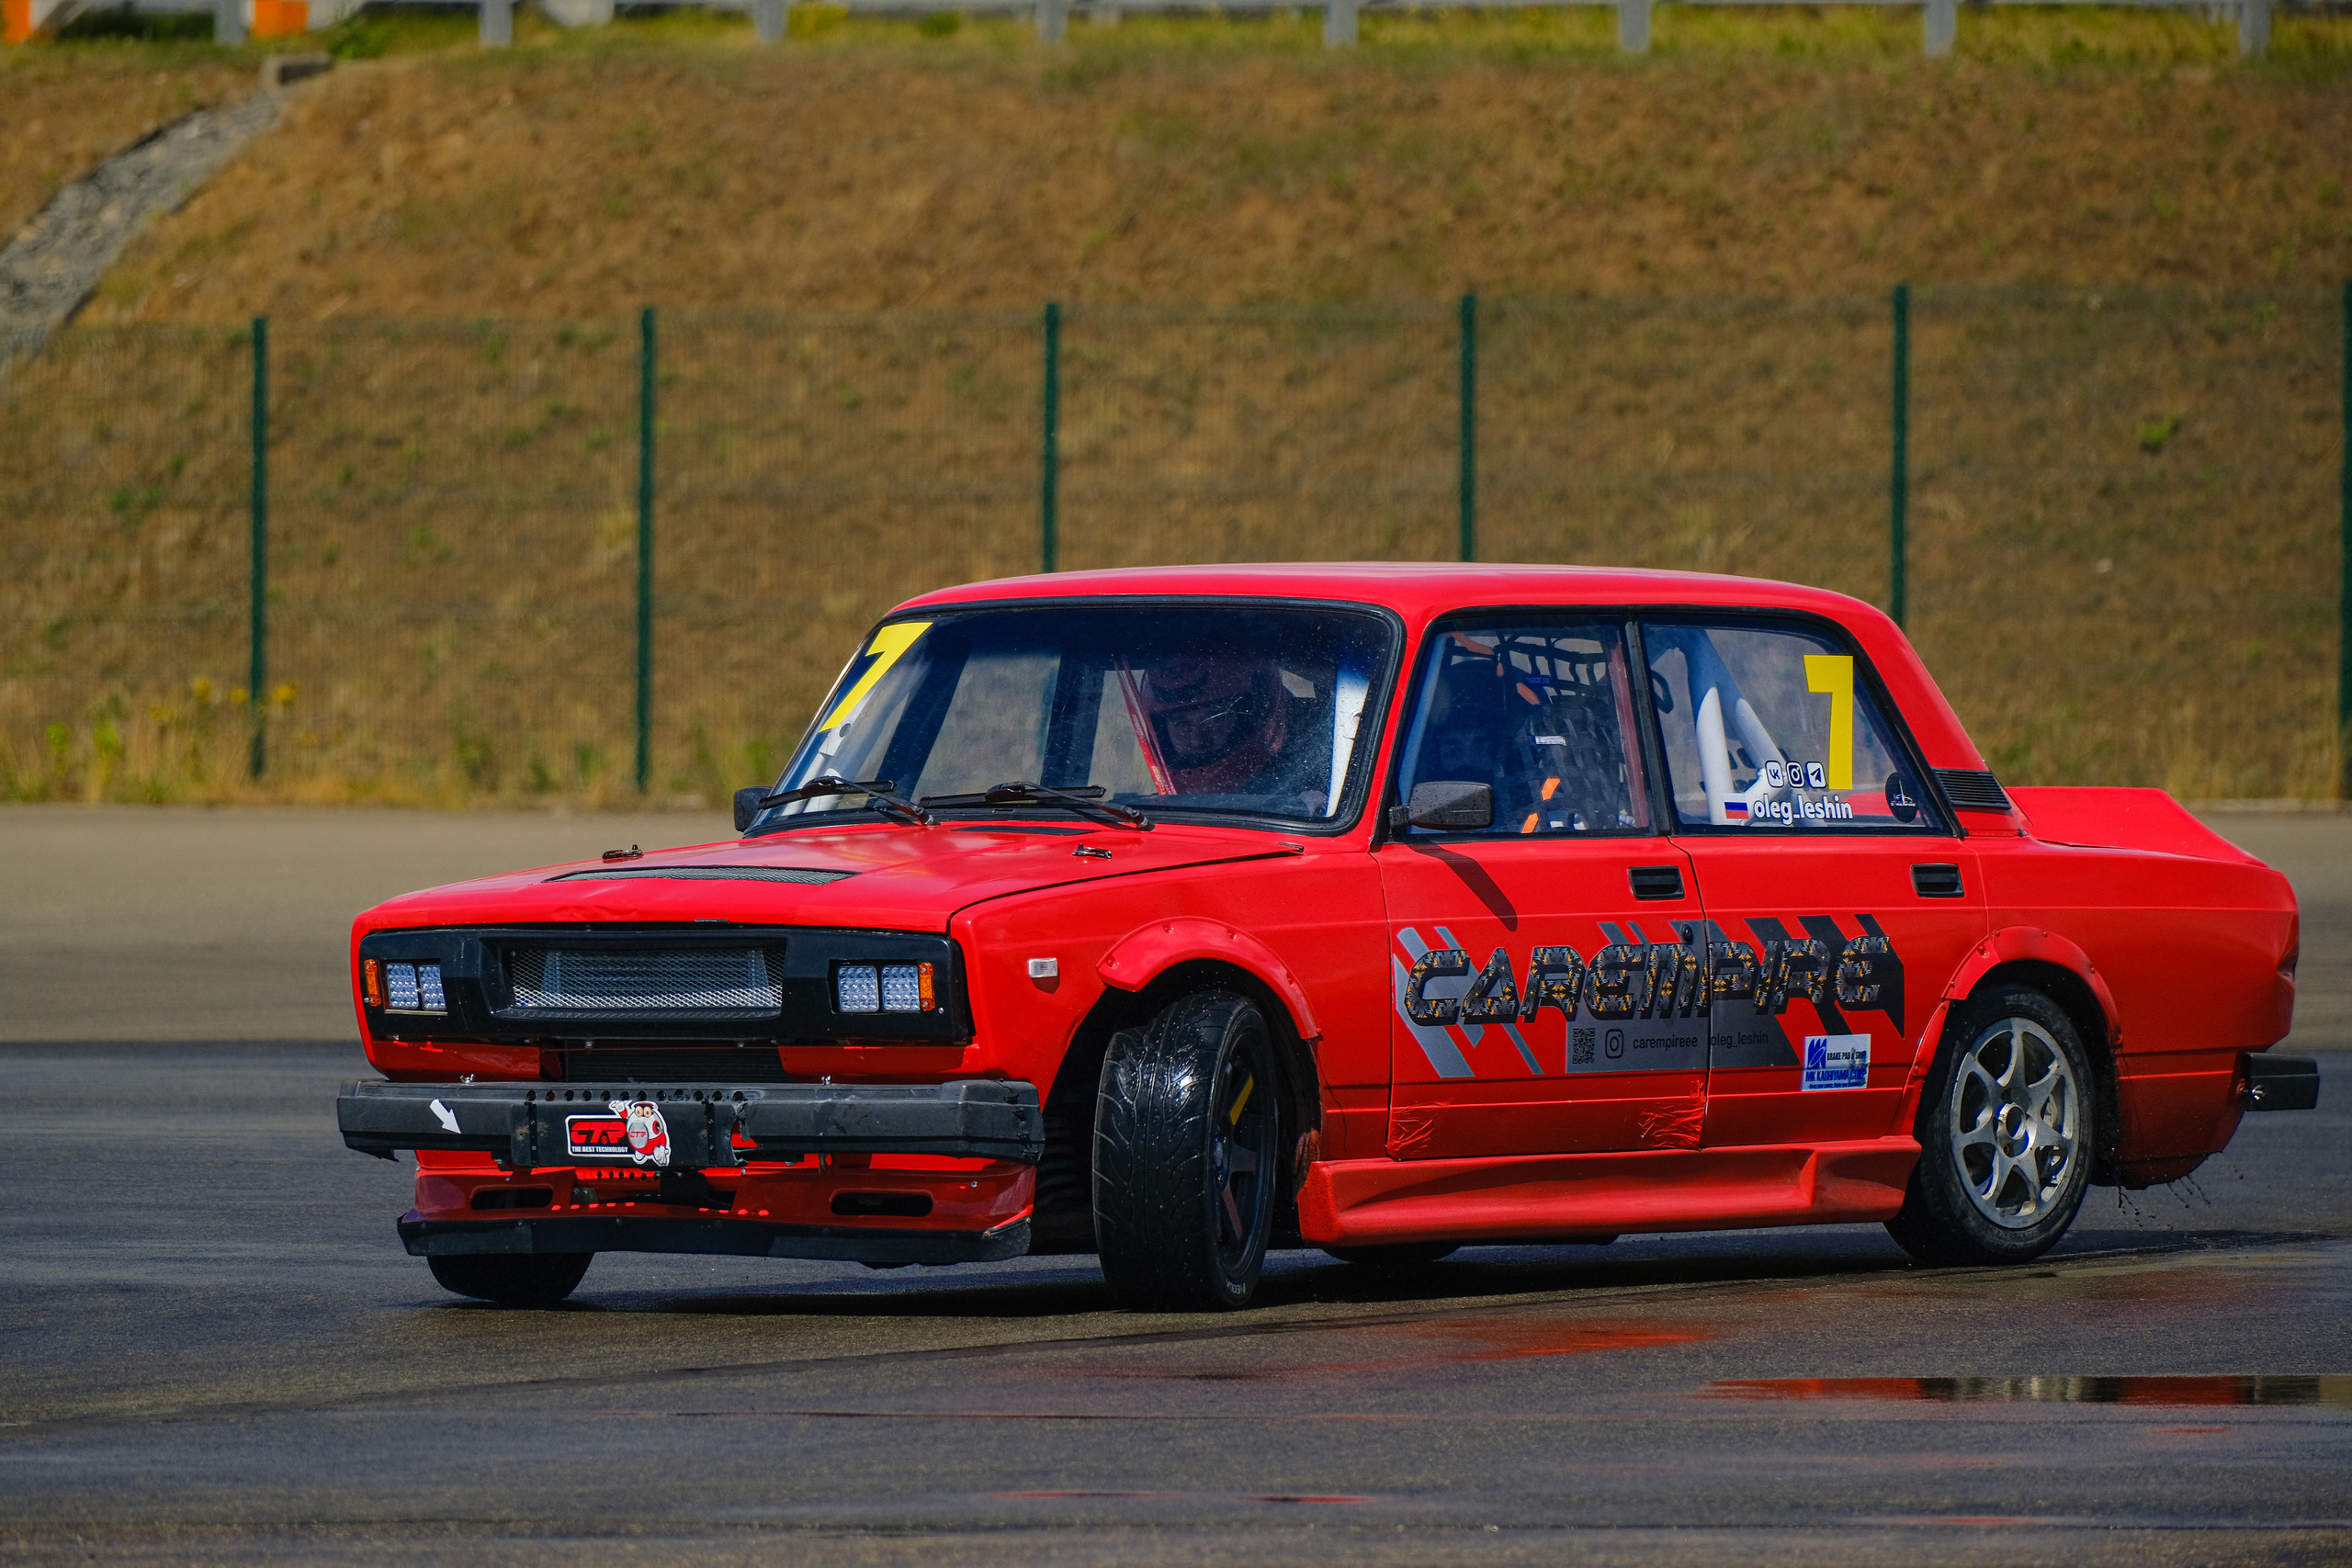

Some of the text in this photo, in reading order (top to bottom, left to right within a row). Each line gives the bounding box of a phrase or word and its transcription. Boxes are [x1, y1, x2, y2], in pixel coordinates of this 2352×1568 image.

[820, 622, 933, 732] 7
[1804, 654, 1853, 789] 7
[1754, 794, 1853, 825] oleg_leshin
[1404, 935, 1891, 1026] CAREMPIRE
[1633, 1031, 1769, 1051] carempireee oleg_leshin
[1805, 1071, 1815, 1082] MK
[1816, 1069, 1849, 1081] KASHIYAMA
[571, 1122, 627, 1144] CTR
